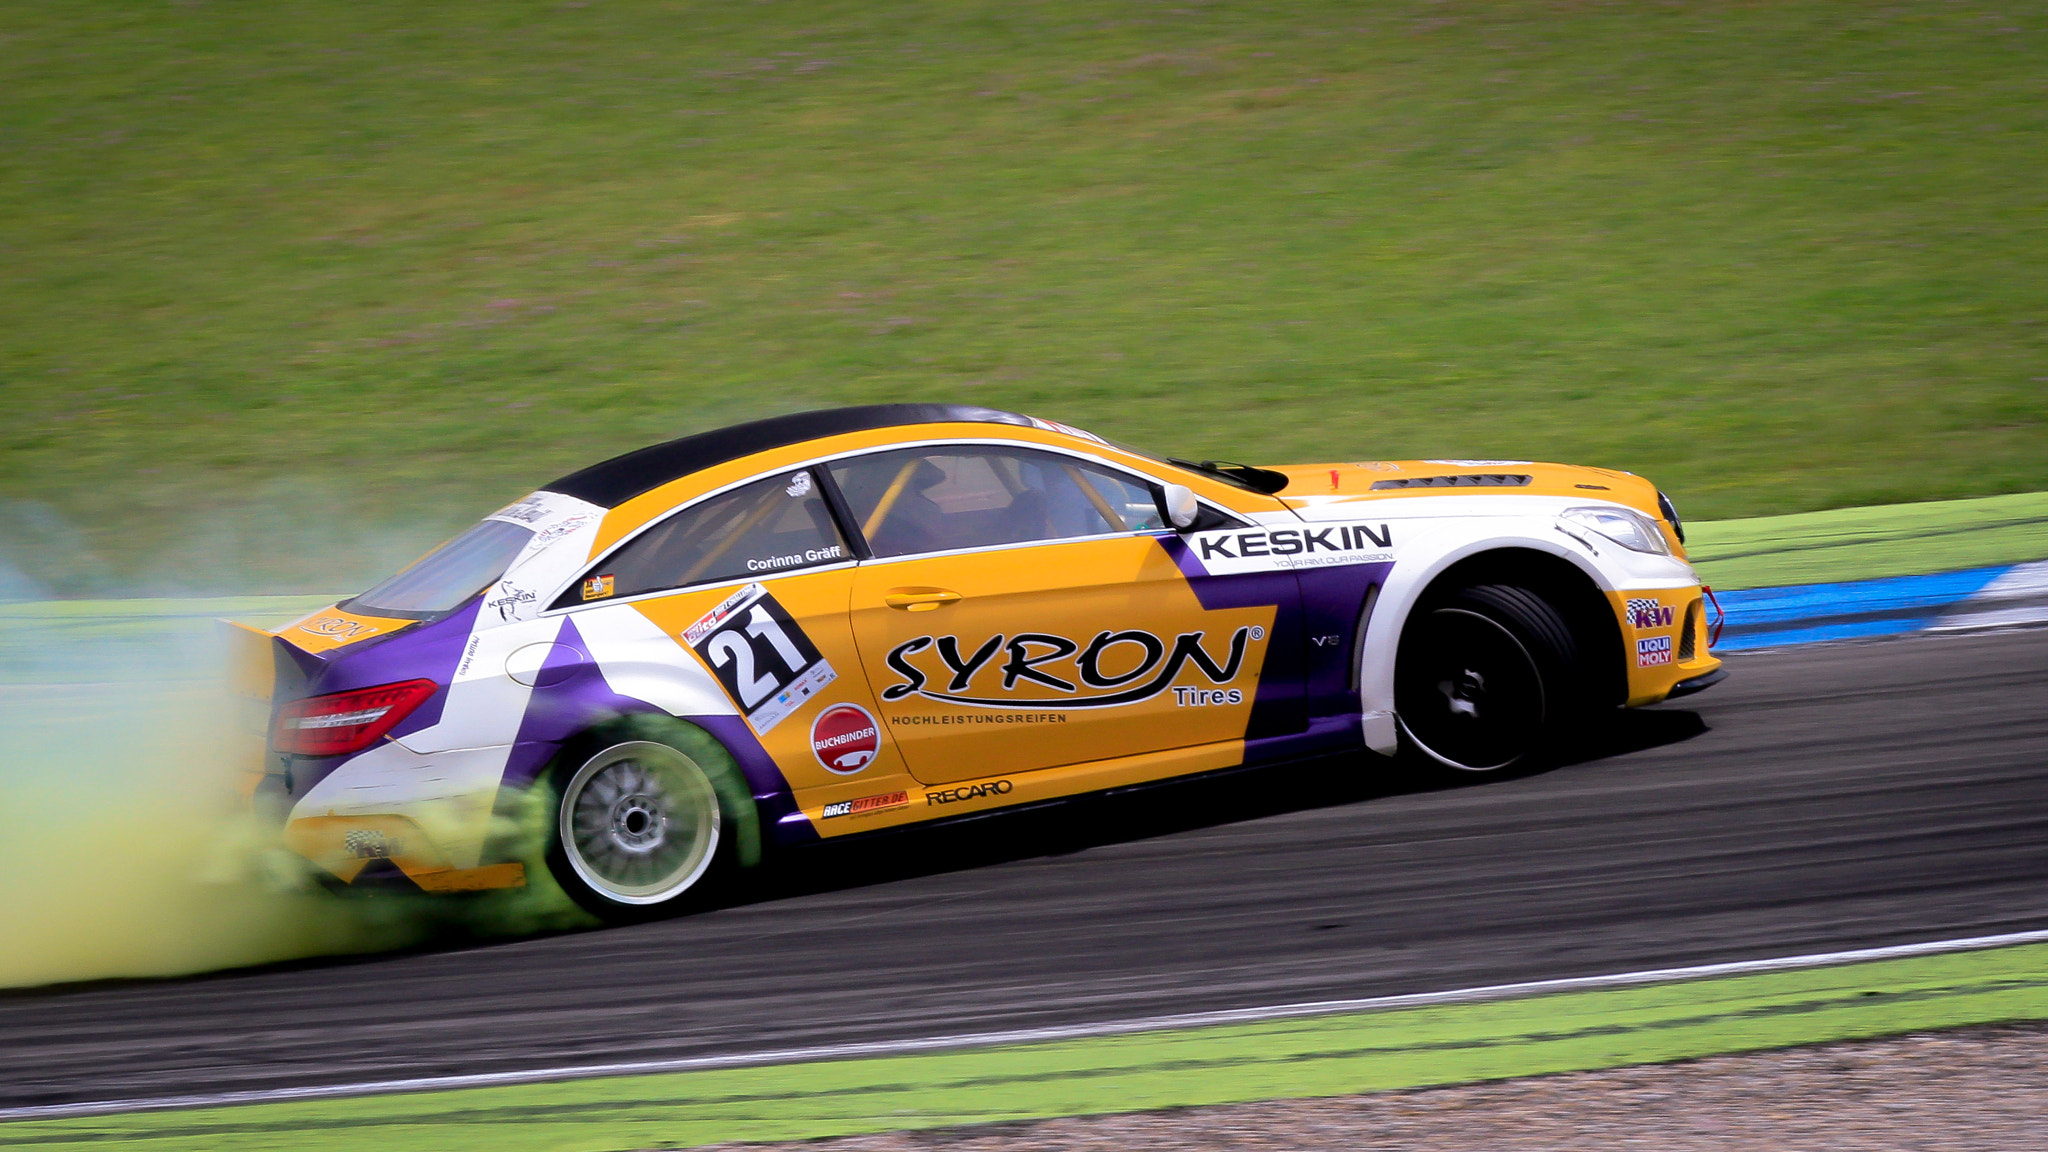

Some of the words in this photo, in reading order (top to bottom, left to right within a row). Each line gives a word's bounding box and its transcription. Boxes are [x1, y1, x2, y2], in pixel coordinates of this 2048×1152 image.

[1199, 523, 1393, 560] KESKIN
[746, 554, 803, 571] Corinna
[805, 545, 841, 561] Gräff
[1273, 560, 1302, 568] YOUR
[487, 591, 536, 608] KESKIN
[1635, 605, 1676, 629] KW
[707, 602, 808, 709] 21
[1638, 638, 1670, 654] LIQUI
[881, 625, 1250, 710] SYRON
[1639, 651, 1671, 666] MOLY
[1171, 685, 1243, 708] Tires
[891, 713, 1067, 726] HOCHLEISTUNGSREIFEN
[815, 727, 875, 750] BUCHBINDER
[925, 779, 1013, 807] RECARO
